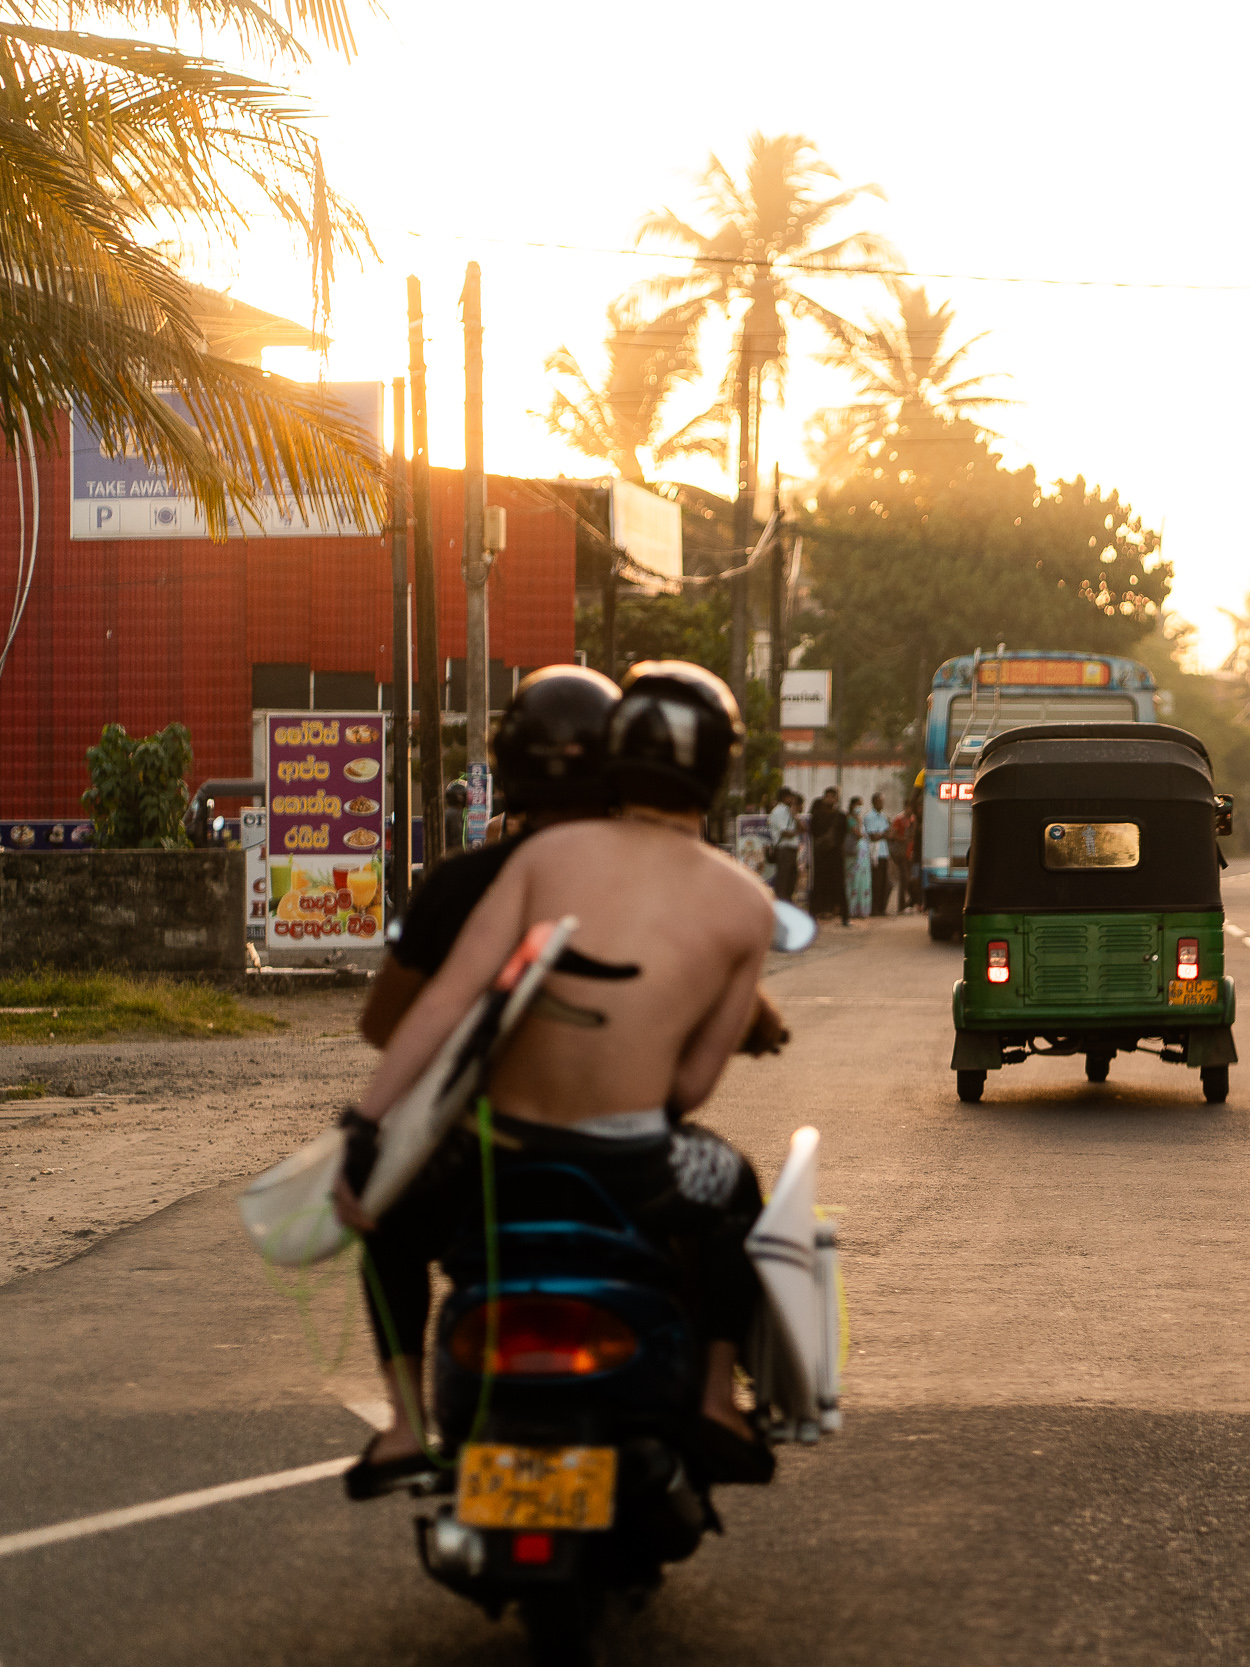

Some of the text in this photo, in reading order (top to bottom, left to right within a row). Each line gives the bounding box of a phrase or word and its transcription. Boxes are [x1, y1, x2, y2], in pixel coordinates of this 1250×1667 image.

[86, 480, 126, 498] TAKE
[129, 480, 172, 497] AWAY
[96, 506, 113, 529] P
[278, 754, 330, 784] ආප්ප
